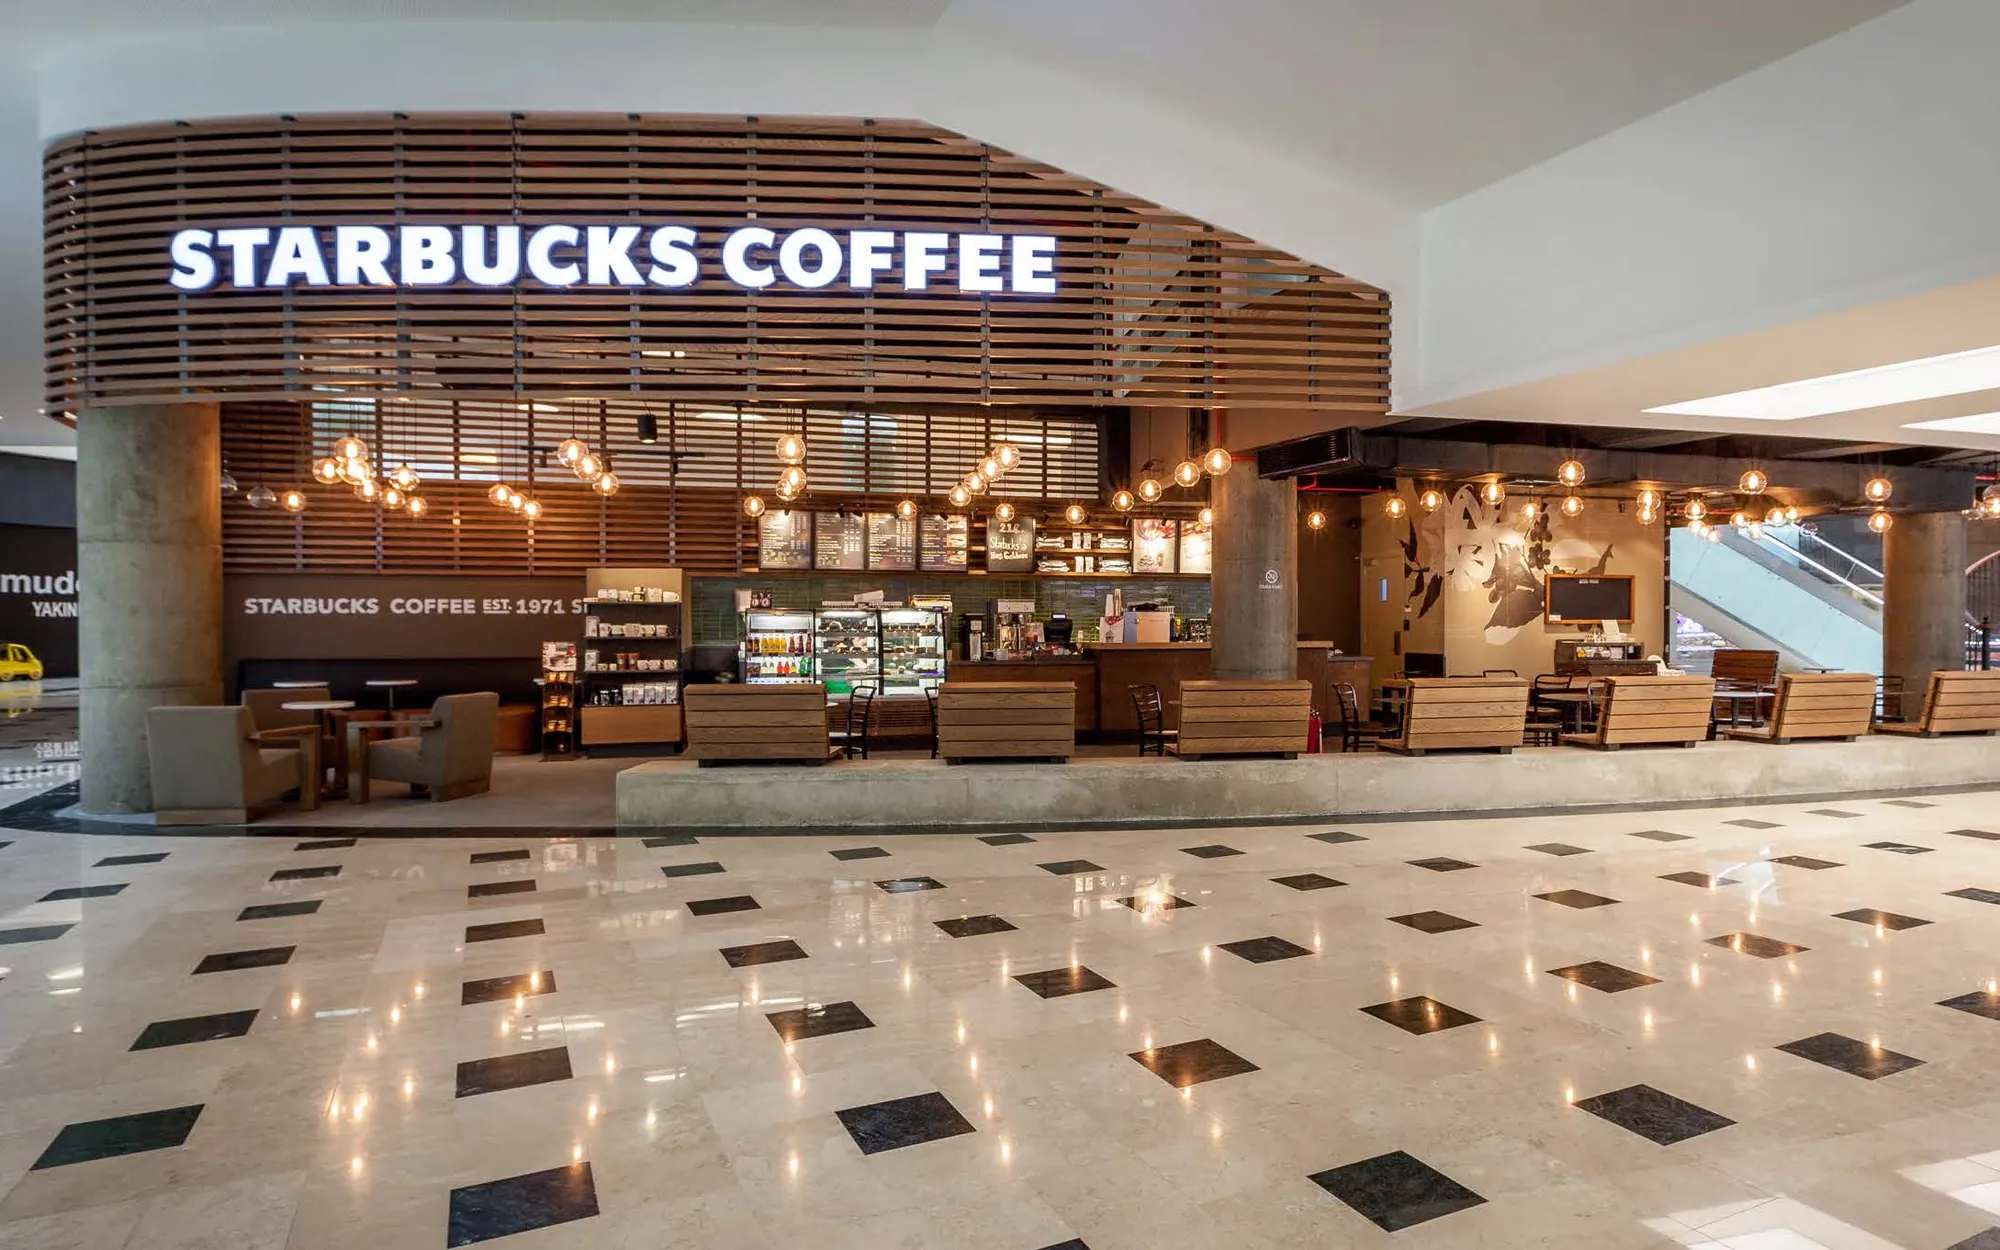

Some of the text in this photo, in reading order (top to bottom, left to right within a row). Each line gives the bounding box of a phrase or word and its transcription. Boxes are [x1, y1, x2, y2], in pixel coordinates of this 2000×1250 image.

[169, 225, 1057, 294] STARBUCKS COFFEE
[244, 598, 379, 614] STARBUCKS
[390, 598, 476, 614] COFFEE
[483, 599, 512, 614] EST.
[516, 599, 565, 614] 1971
